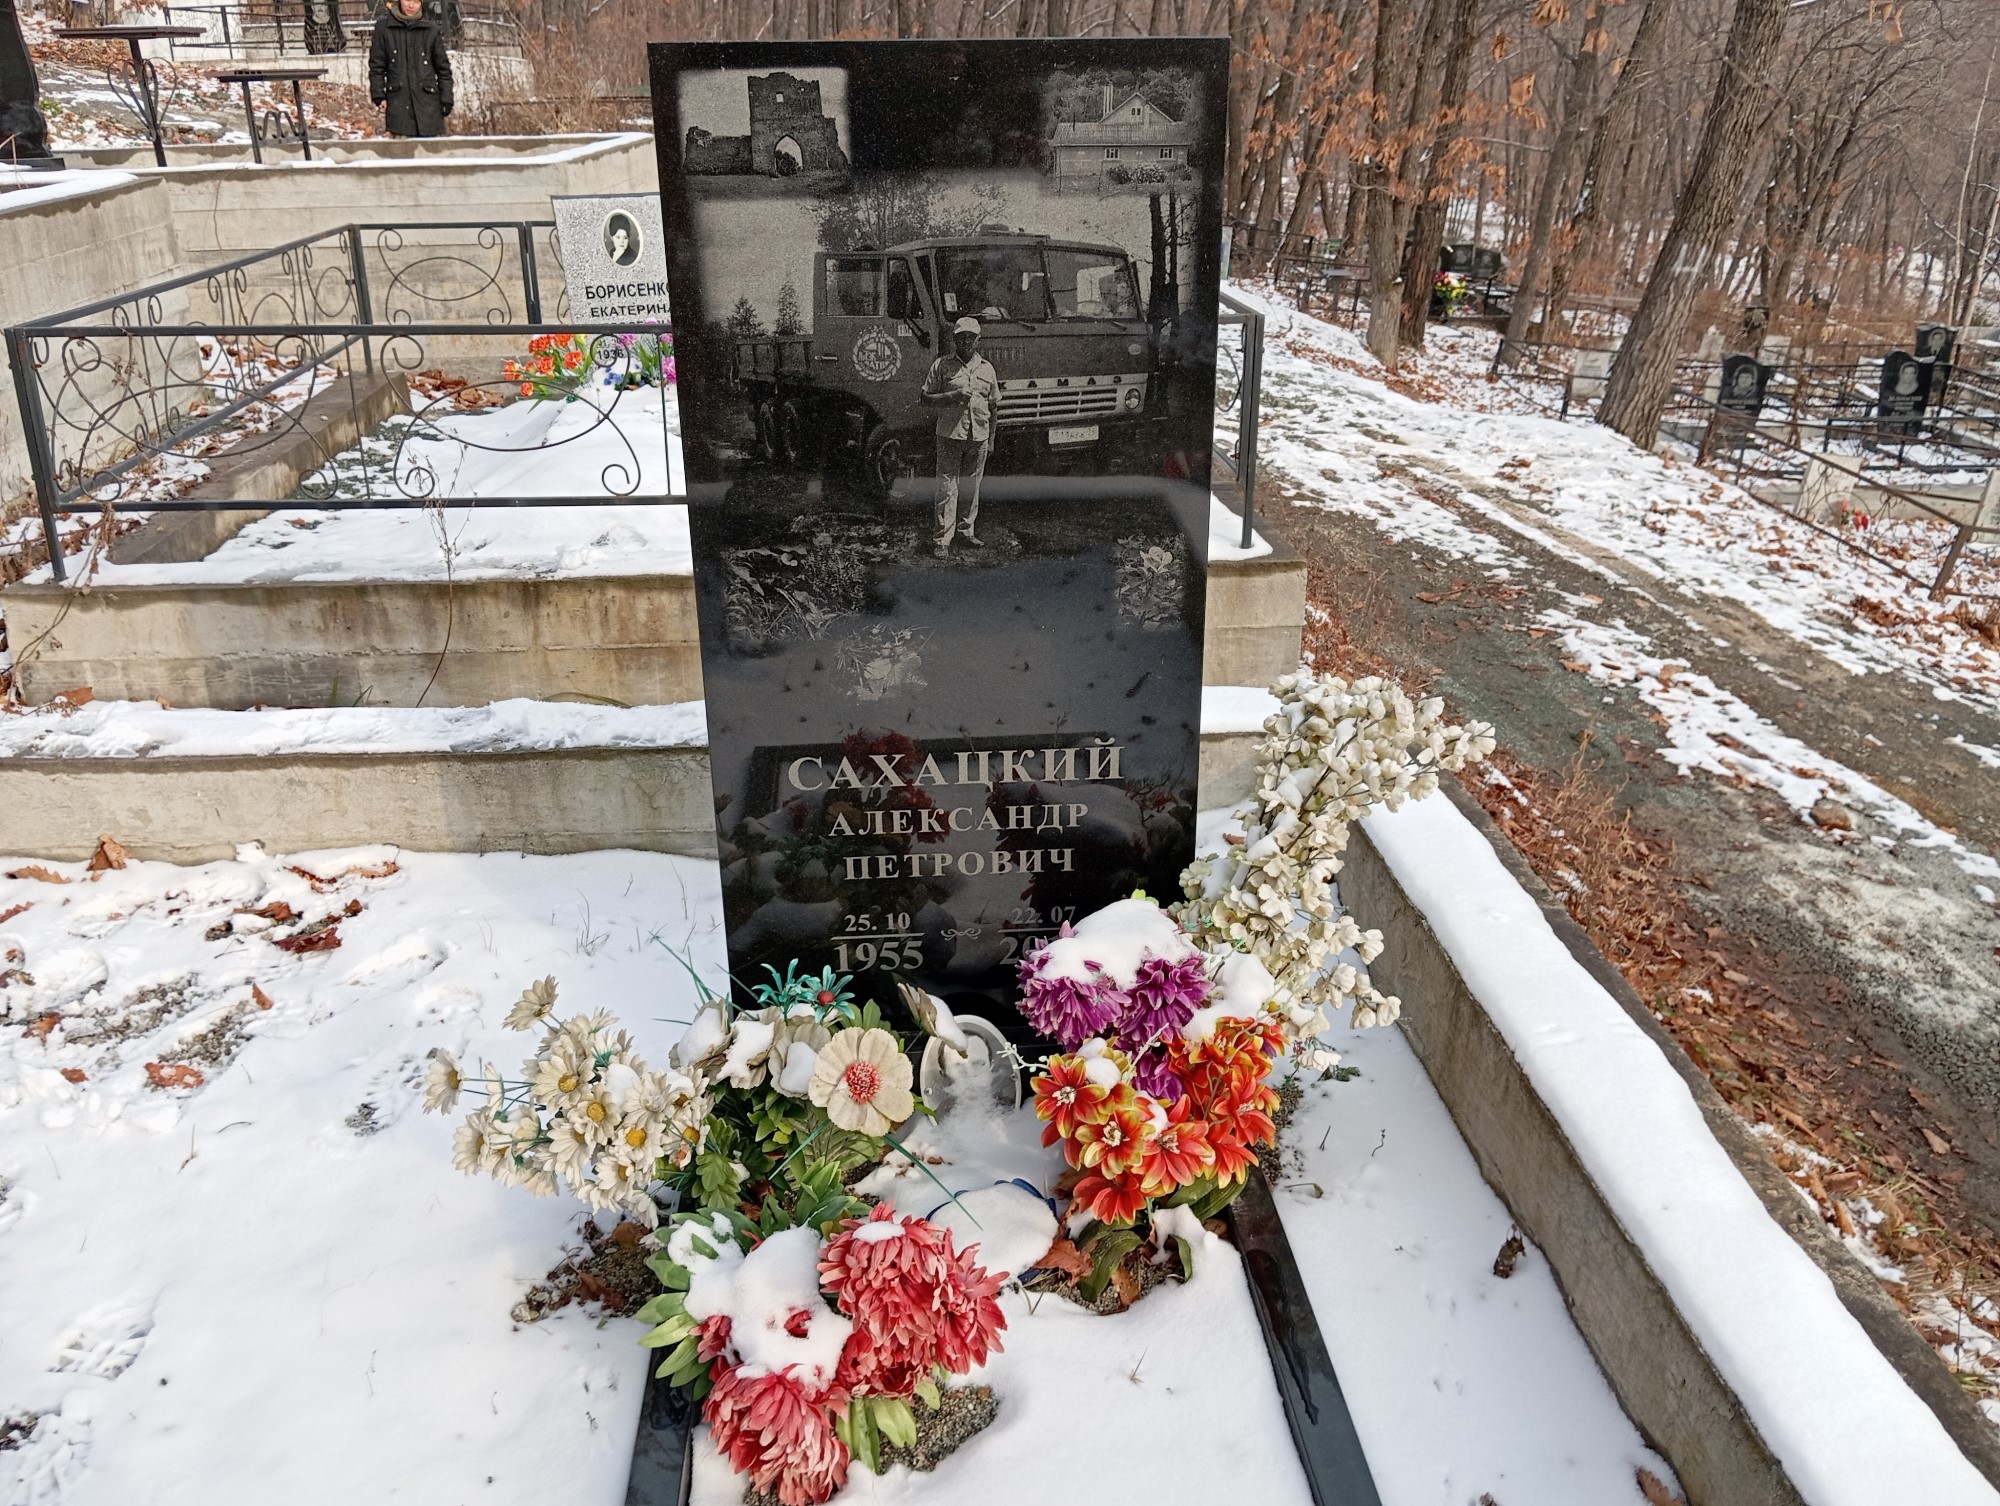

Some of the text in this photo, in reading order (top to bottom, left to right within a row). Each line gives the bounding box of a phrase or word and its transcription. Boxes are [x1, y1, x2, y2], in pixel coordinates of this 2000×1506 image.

[590, 303, 671, 318] ЕКАТЕРИН
[788, 737, 1125, 792] САХАЦКИЙ
[828, 803, 1090, 837] АЛЕКСАНДР
[843, 848, 1076, 881] ПЕТРОВИЧ
[844, 911, 911, 932] 25. 10
[1010, 905, 1076, 925] 22. 07
[834, 940, 924, 973] 1955
[1000, 936, 1044, 965] 20
